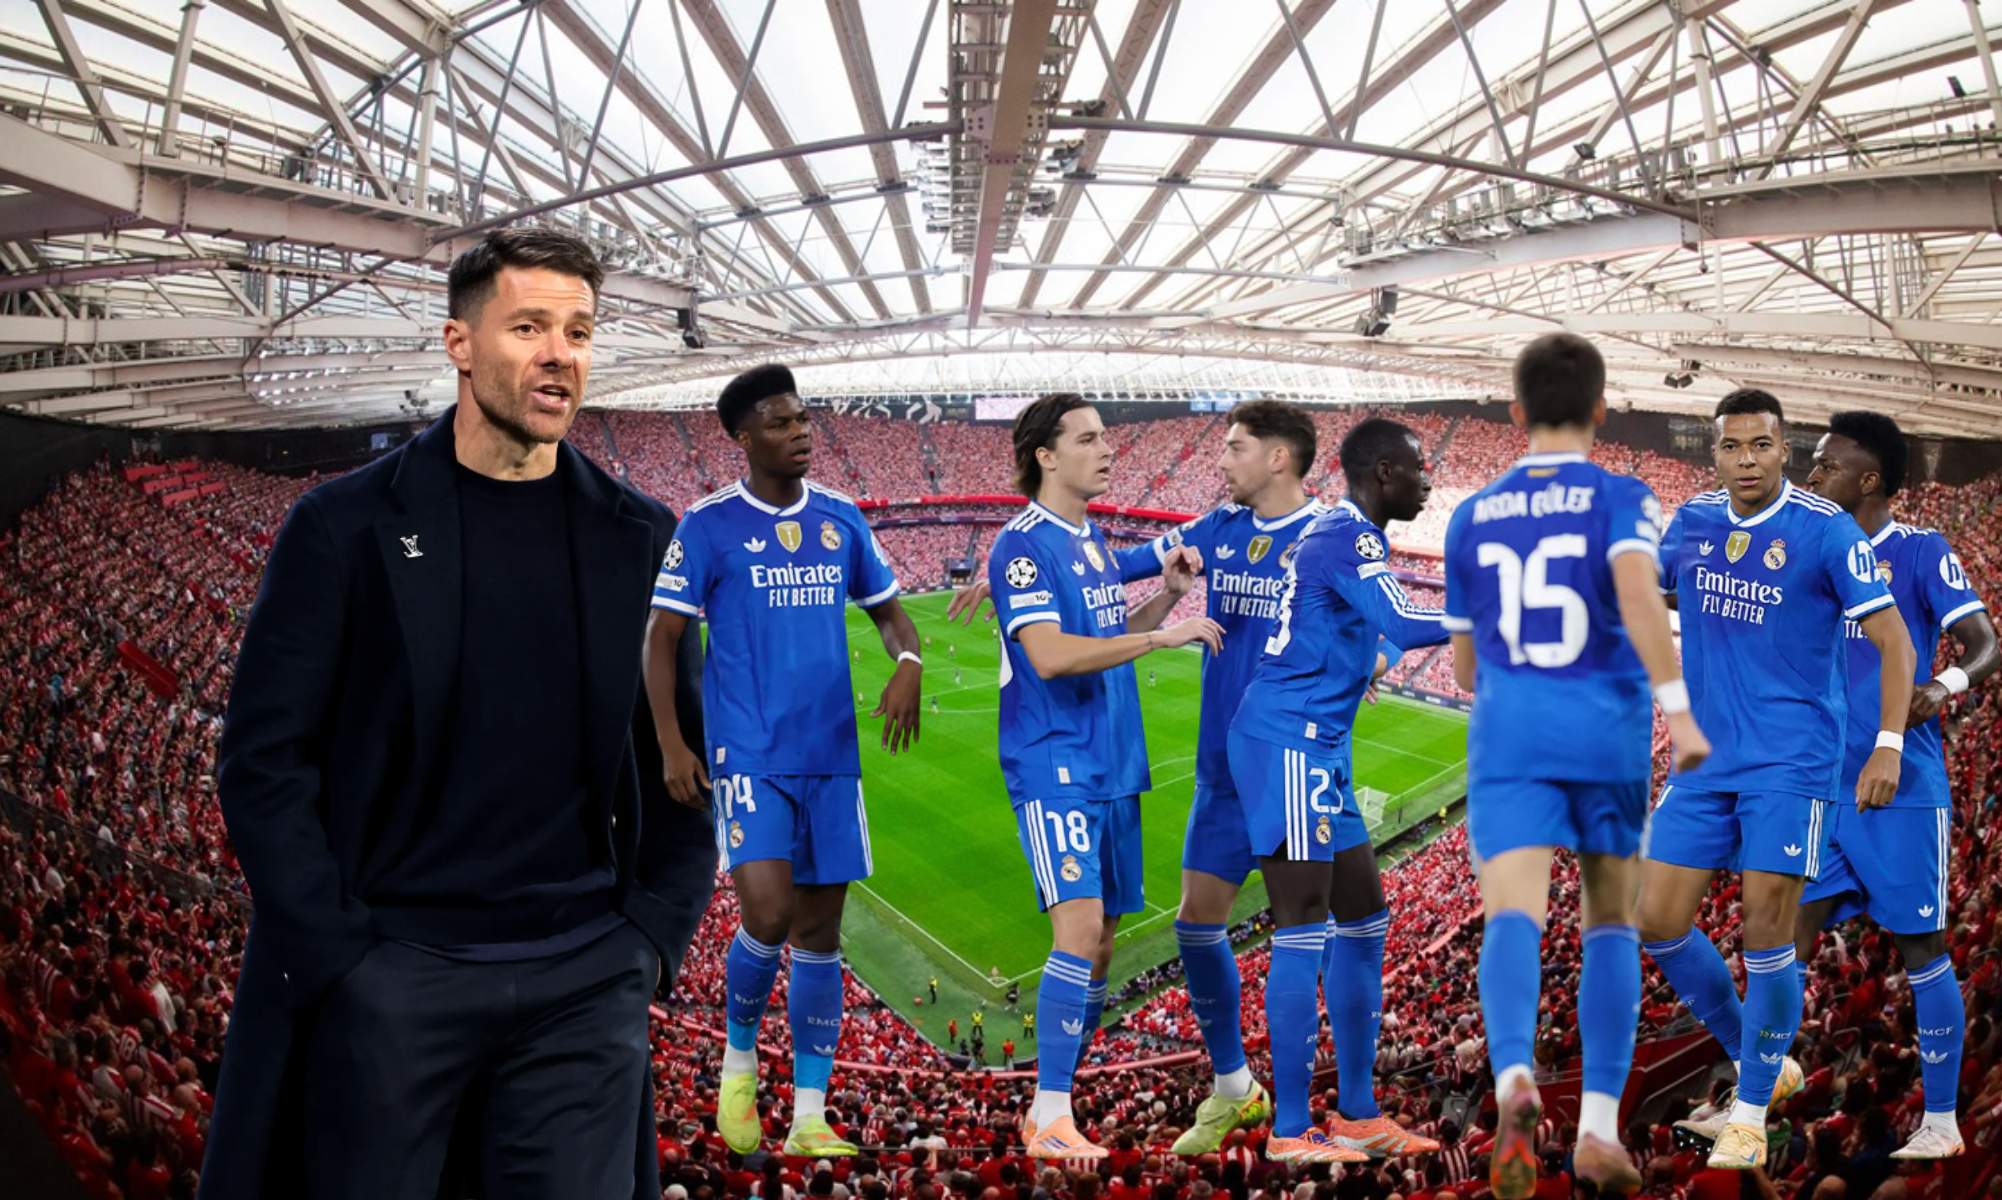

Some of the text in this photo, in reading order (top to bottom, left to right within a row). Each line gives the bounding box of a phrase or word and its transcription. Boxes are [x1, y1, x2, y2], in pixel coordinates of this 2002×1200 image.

[749, 561, 842, 588] Emirates
[1212, 568, 1285, 598] Emirate
[1696, 566, 1783, 605] Emirates
[769, 586, 835, 608] FLY BETTER
[1221, 595, 1279, 619] FLY BETTER
[1477, 534, 1589, 668] 15
[1702, 594, 1764, 625] FLY BETTER
[1045, 810, 1091, 853] 18
